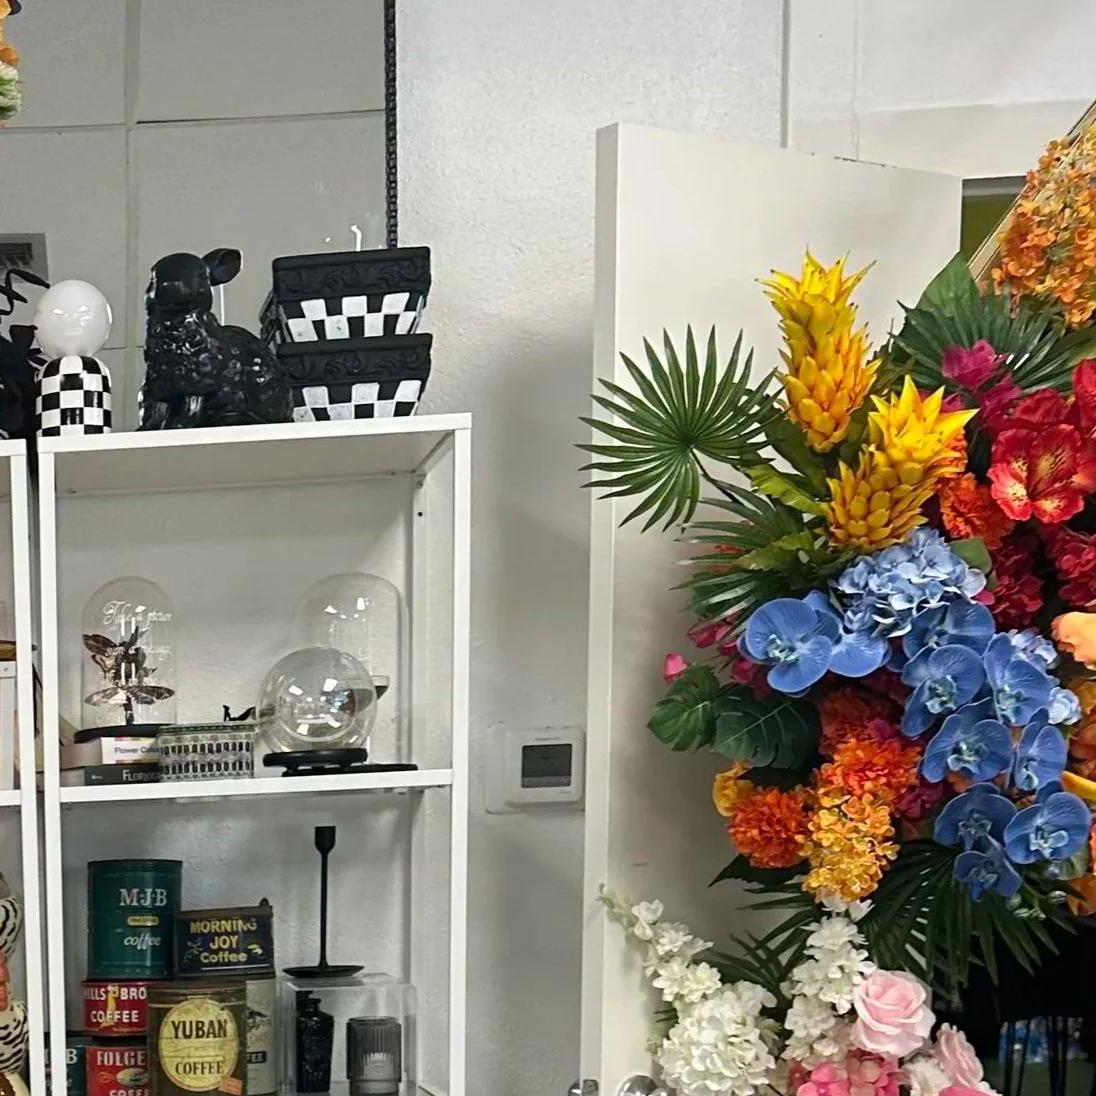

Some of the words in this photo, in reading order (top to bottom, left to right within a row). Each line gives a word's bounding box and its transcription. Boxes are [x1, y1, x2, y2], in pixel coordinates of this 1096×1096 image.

[189, 919, 257, 934] MORNING
[123, 932, 162, 950] coffee
[209, 935, 239, 950] JOY
[200, 952, 248, 963] Coffee
[90, 1010, 139, 1023] COFFEE
[171, 1019, 227, 1039] YUBAN
[175, 1061, 224, 1075] COFFEE
